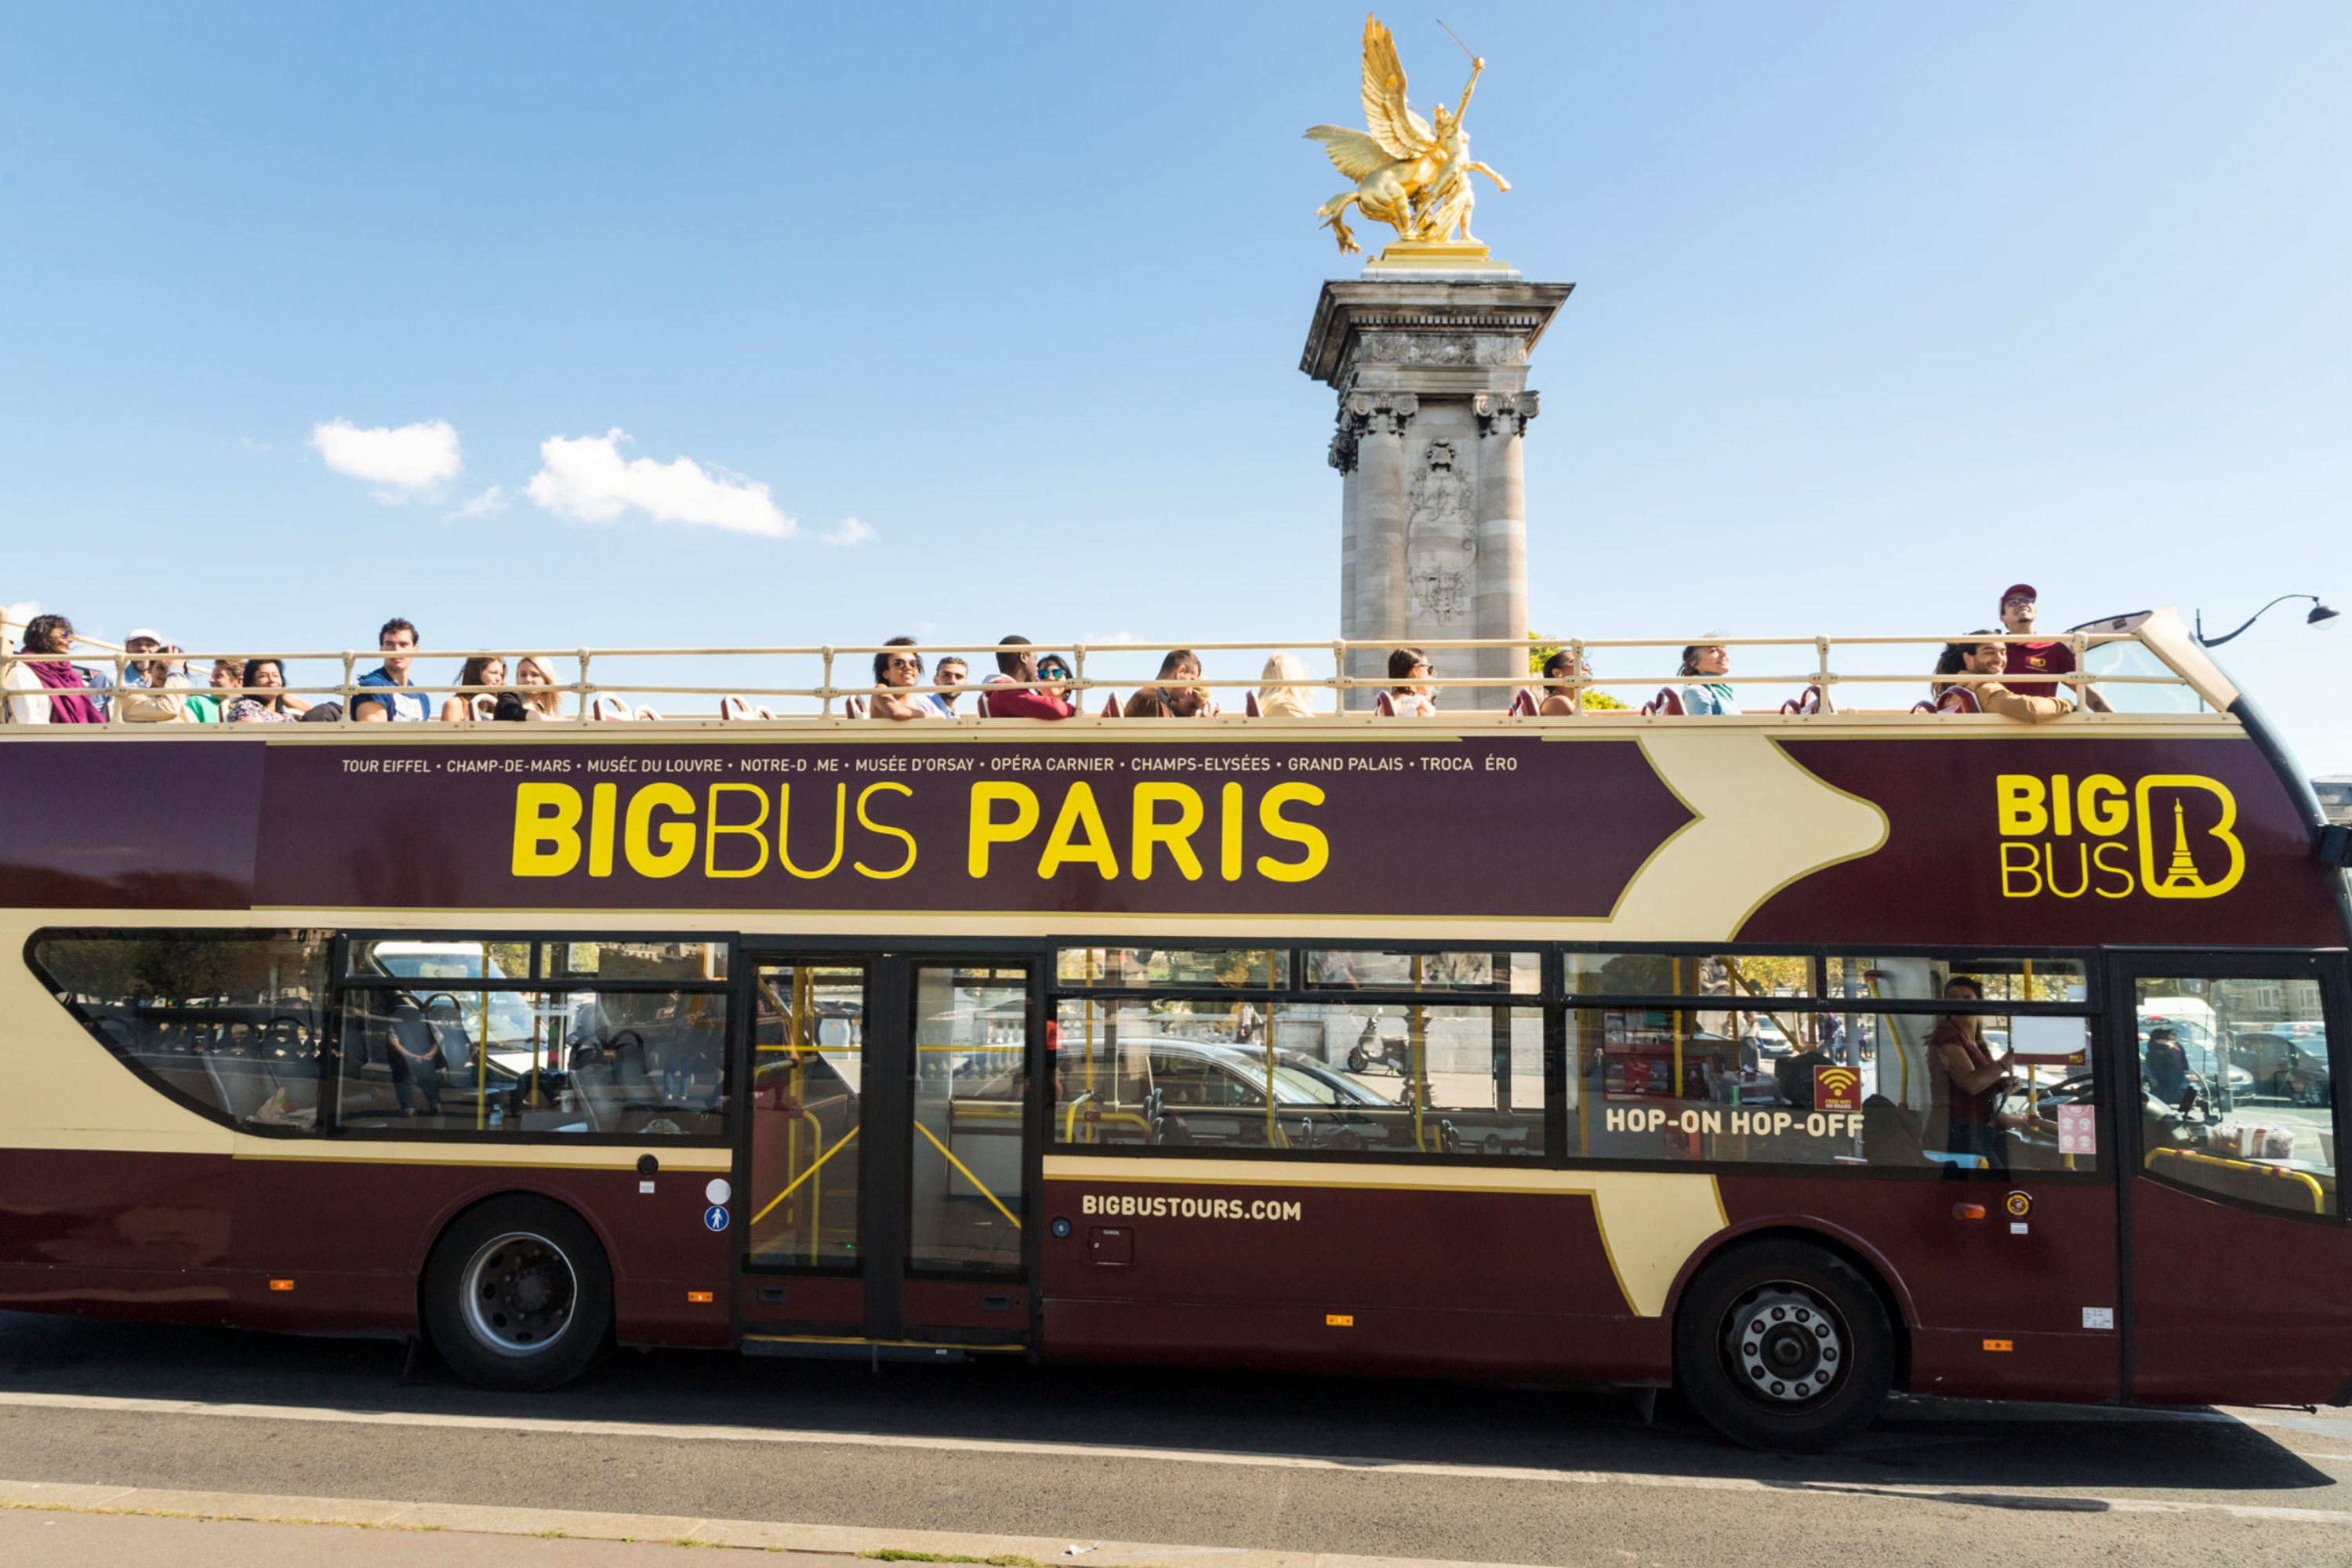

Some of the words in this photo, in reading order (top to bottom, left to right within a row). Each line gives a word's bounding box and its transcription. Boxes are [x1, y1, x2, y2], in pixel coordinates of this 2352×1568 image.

[342, 759, 379, 773] TOUR
[383, 760, 431, 773] EIFFEL
[446, 759, 572, 773] CHAMP-DE-MARS
[641, 759, 662, 773] DU
[666, 758, 723, 772] LOUVRE
[740, 758, 840, 772] NOTRE-DME
[855, 754, 908, 772] MUSÉE
[911, 757, 975, 771] D'ORSAY
[990, 753, 1043, 771] OPÉRA
[1131, 753, 1271, 771] CHAMPS-ELYSÉES
[1287, 757, 1344, 771] GRAND
[1348, 757, 1404, 771] PALAIS
[1420, 753, 1518, 771] TROCAÉRO
[1996, 774, 2129, 837] BIG
[967, 781, 1330, 883] PARIS
[2000, 841, 2135, 898] BUS
[1606, 1108, 1722, 1134] HOP-ON
[1731, 1111, 1865, 1138] HOP-OFF
[1083, 1195, 1301, 1221] BIGBUSTOURS.COM
